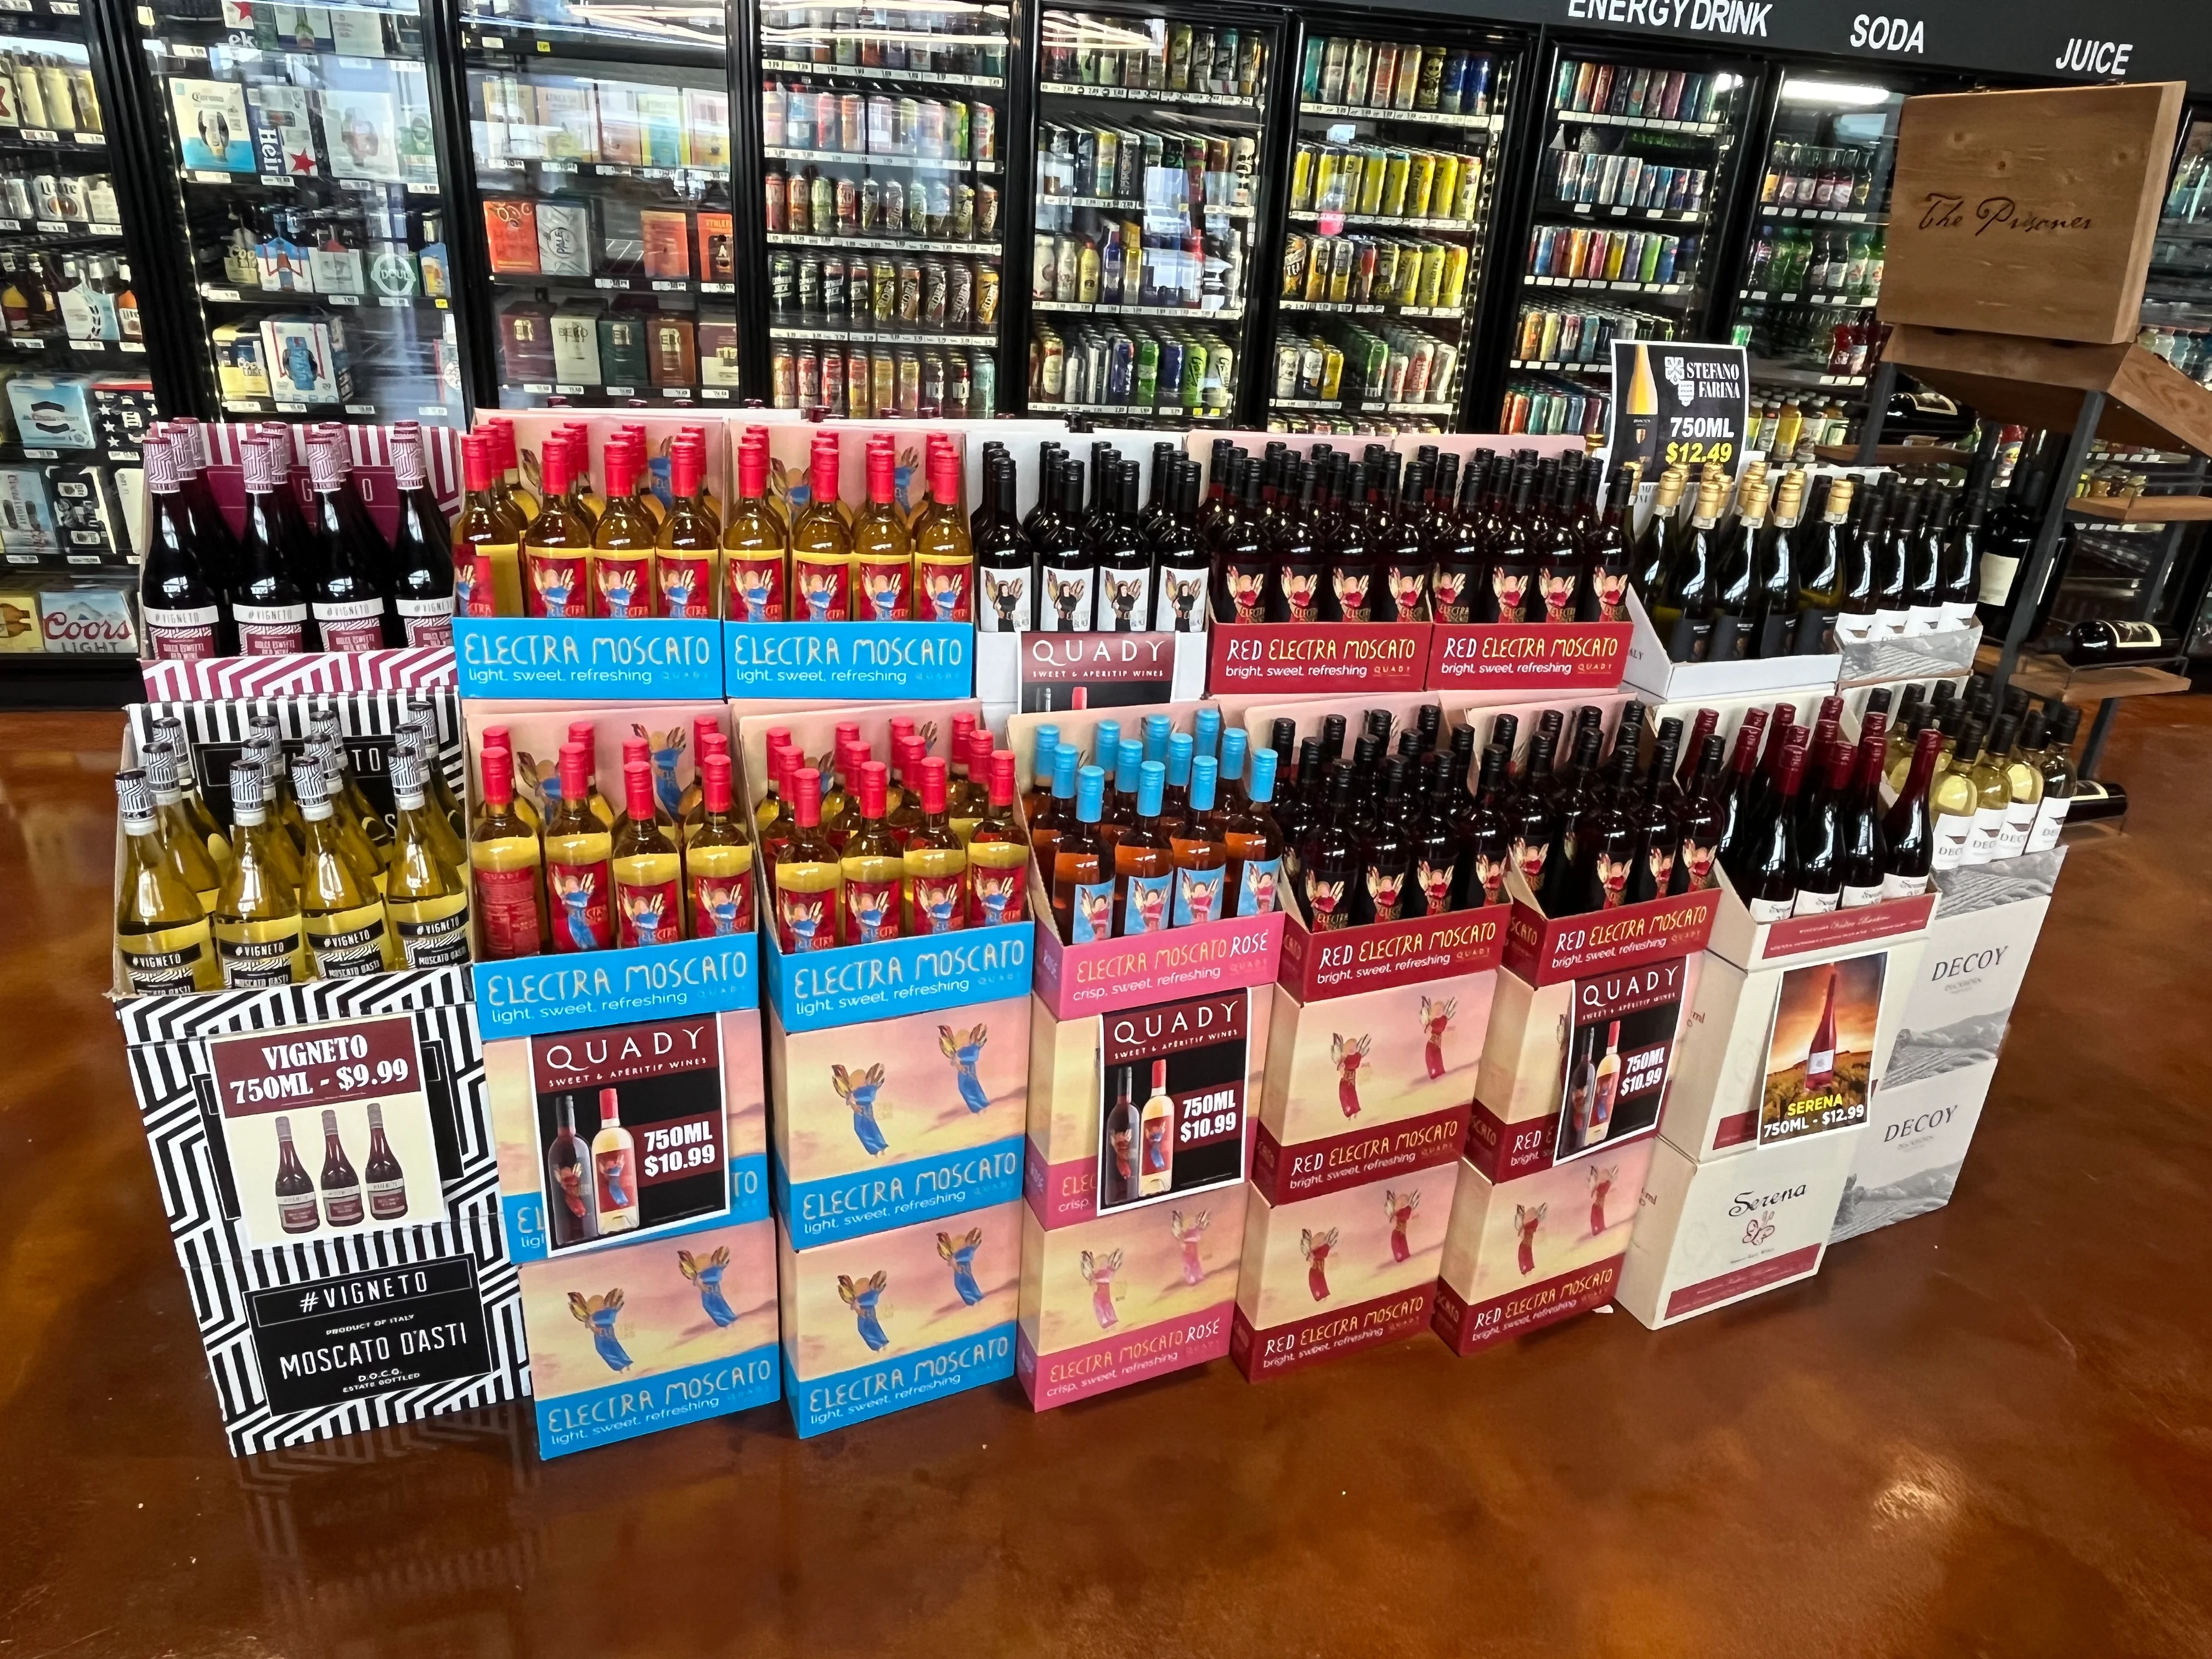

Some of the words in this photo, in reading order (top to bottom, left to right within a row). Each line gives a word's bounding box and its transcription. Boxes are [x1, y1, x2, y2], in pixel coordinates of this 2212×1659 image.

[1567, 0, 1685, 30] ENERGY
[1690, 0, 1773, 37] DRINK
[1850, 14, 1925, 54] SODA
[2055, 38, 2134, 75] JUICE
[1918, 193, 1963, 230] The
[1975, 195, 2092, 237] Prisoner
[1686, 362, 1740, 380] STEFANO
[1699, 381, 1740, 398] FARINA
[1671, 417, 1735, 438] 750ML
[1665, 442, 1733, 465] $12.49
[43, 612, 132, 640] Coors
[61, 642, 119, 653] LIGHT
[465, 633, 579, 665] ELECTRA
[592, 636, 710, 665] MOSCATO
[735, 635, 840, 665] ELECTRA
[853, 637, 962, 665] MOSCATO
[1032, 640, 1165, 666] QUADY
[1227, 639, 1262, 661] RED
[1269, 639, 1336, 661] ELECTRA
[1344, 639, 1415, 659] MOSCATO
[1443, 637, 1477, 658] RED
[1482, 637, 1545, 658] ELECTRA
[1551, 637, 1618, 657] MOSCATO
[571, 669, 652, 684] refreshing
[832, 669, 907, 685] refreshing
[1308, 664, 1367, 678] refreshing
[1517, 662, 1572, 675] refreshing
[1555, 930, 1585, 955] RED
[1589, 918, 1645, 947] ELECTRA
[1649, 906, 1707, 935] MOSCATO
[1319, 945, 1353, 970] RED
[1359, 933, 1423, 962] ELECTRA
[1429, 922, 1496, 950] MOSCATO
[794, 957, 903, 1000] ELECTRA
[915, 939, 1024, 980] MOSCATO
[1077, 952, 1147, 984] ELECTRA
[1154, 939, 1227, 969] MOSCATO
[1157, 967, 1221, 986] refreshing
[1395, 954, 1451, 972] refreshing
[1931, 945, 2009, 981] DECOY
[488, 968, 612, 1007] ELECTRA
[625, 951, 748, 992] MOSCATO
[894, 979, 969, 1000] refreshing
[1583, 965, 1679, 1007] QUADY
[602, 992, 687, 1011] refreshing
[1114, 1000, 1238, 1045] QUADY
[1208, 1029, 1238, 1040] WINES
[262, 1034, 368, 1071] VIGNETO
[546, 1026, 704, 1071] QUADY
[1626, 1047, 1666, 1074] 750ML
[230, 1071, 314, 1104] 750ML
[336, 1058, 409, 1091] $9.99
[549, 1074, 589, 1087] SWEET
[610, 1064, 663, 1079] APERITIF
[669, 1057, 707, 1069] WINES
[1620, 1067, 1663, 1097] $10.99
[1182, 1089, 1236, 1119] 750ML
[1787, 1093, 1843, 1116] SERENA
[1180, 1111, 1237, 1143] $10.99
[1764, 1118, 1809, 1138] 750ML
[1821, 1104, 1864, 1126] $12.99
[1883, 1104, 1959, 1143] DECOY
[644, 1121, 712, 1152] 750ML
[1291, 1153, 1323, 1176] RED
[1329, 1137, 1390, 1167] ELECTRA
[1395, 1121, 1458, 1152] MOSCATO
[1513, 1130, 1541, 1153] RED
[644, 1144, 715, 1177] $10.99
[803, 1178, 905, 1221] ELECTRA
[916, 1152, 1017, 1195] MOSCATO
[1062, 1173, 1097, 1196] ELEC
[894, 1190, 966, 1215] refreshing
[1728, 1184, 1807, 1217] Serena
[300, 1271, 427, 1313] #VIGNETO
[1474, 1307, 1502, 1330] RED
[1505, 1288, 1556, 1319] ELECTRA
[1560, 1268, 1613, 1300] MOSCATO
[326, 1322, 371, 1335] PRODUCT
[390, 1314, 415, 1323] ITALY
[1265, 1334, 1295, 1357] RED
[1300, 1316, 1358, 1345] ELECTRA
[1363, 1296, 1424, 1328] MOSCATO
[279, 1336, 390, 1380] MOSCATO
[400, 1322, 467, 1356] D'ASTI
[1049, 1351, 1113, 1383] ELECTRA
[1119, 1330, 1183, 1363] MOSCATO
[342, 1381, 375, 1393] ESTATE
[379, 1372, 421, 1386] BOTTLED
[809, 1368, 904, 1413] ELECTRA
[915, 1336, 1008, 1384] MOSCATO
[895, 1374, 961, 1400] refreshing
[548, 1390, 654, 1432] ELECTRA
[665, 1359, 771, 1406] MOSCATO
[645, 1397, 719, 1423] refreshing
